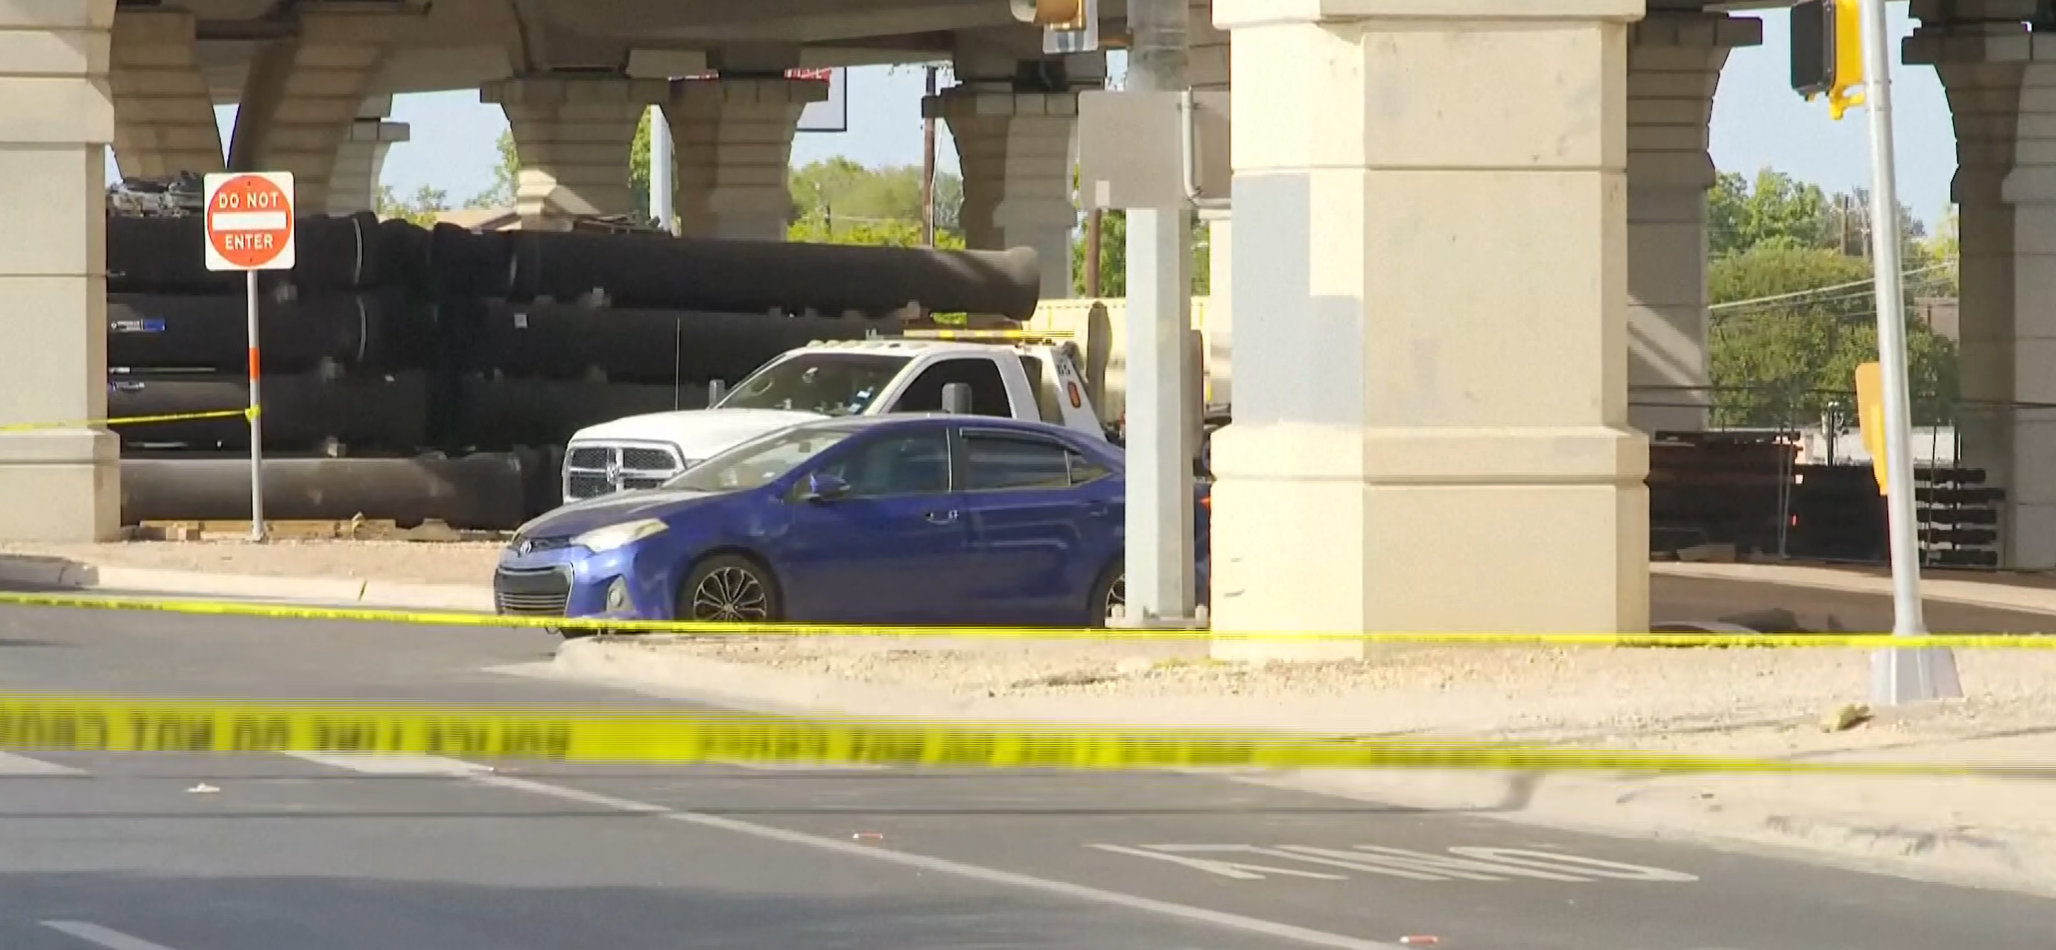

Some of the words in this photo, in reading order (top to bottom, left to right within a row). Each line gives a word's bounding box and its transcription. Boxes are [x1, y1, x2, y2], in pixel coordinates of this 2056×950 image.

[219, 192, 240, 208] DO
[247, 192, 279, 208] NOT
[225, 233, 274, 250] ENTER
